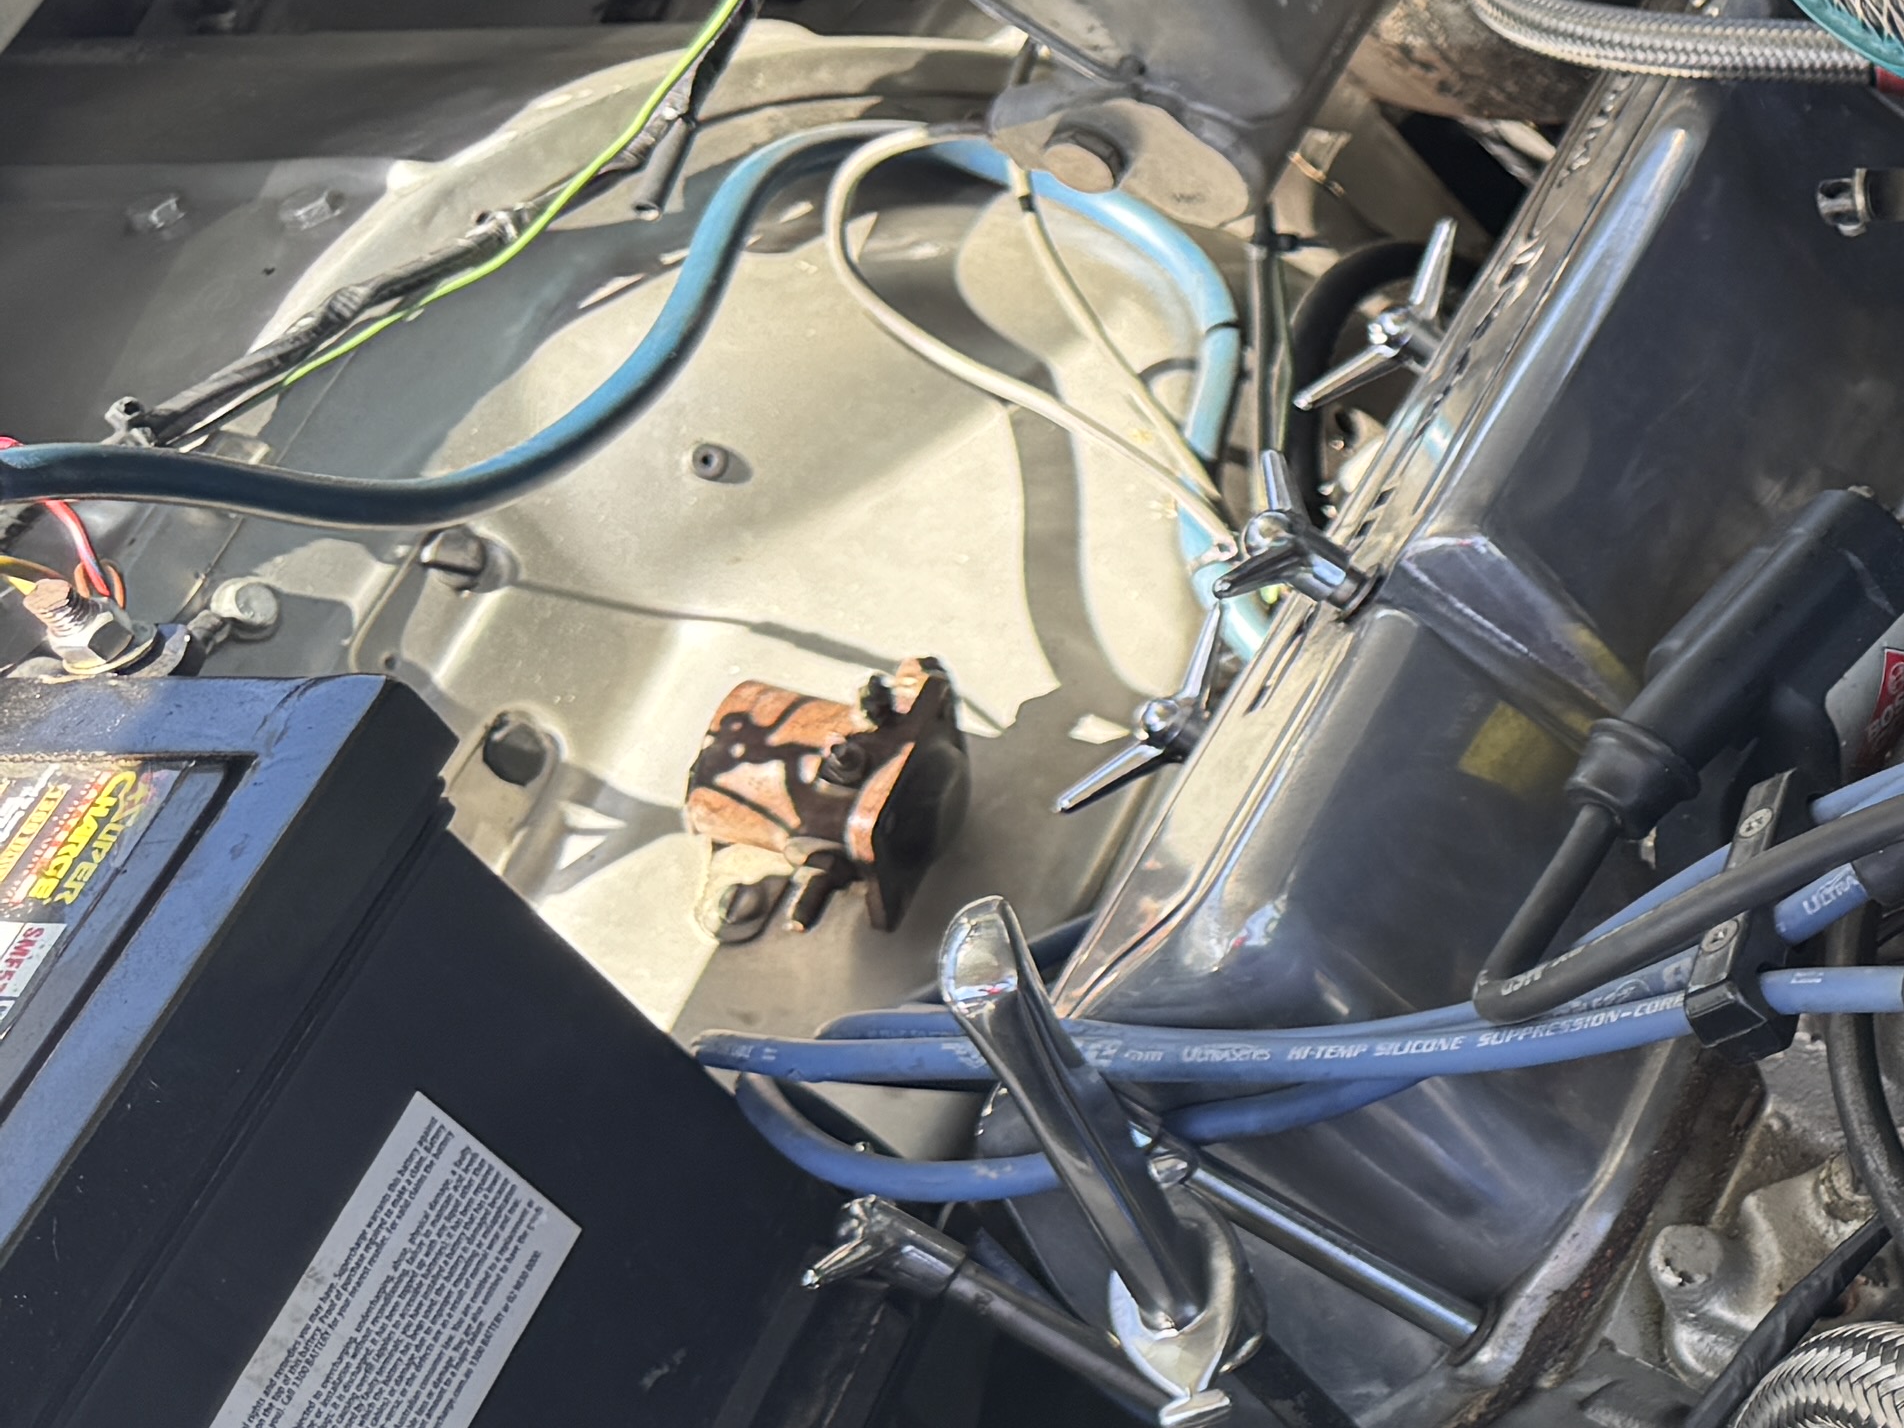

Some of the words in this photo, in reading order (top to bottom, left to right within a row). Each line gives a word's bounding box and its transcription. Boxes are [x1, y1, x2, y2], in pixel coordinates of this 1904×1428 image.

[28, 770, 137, 905] CHARGE
[0, 926, 45, 993] SMF5
[1287, 1042, 1368, 1061] HI-TEMP
[1373, 1035, 1466, 1057] SILICONE
[1476, 993, 1686, 1048] SUPPRESSION-CORE
[244, 1395, 268, 1424] rights
[261, 1377, 277, 1397] and
[260, 1400, 276, 1418] the
[271, 1384, 287, 1403] top
[279, 1373, 292, 1387] of
[286, 1356, 302, 1375] this
[279, 1386, 296, 1407] Call
[291, 1364, 310, 1389] 1300
[304, 1329, 332, 1367] BATTERY
